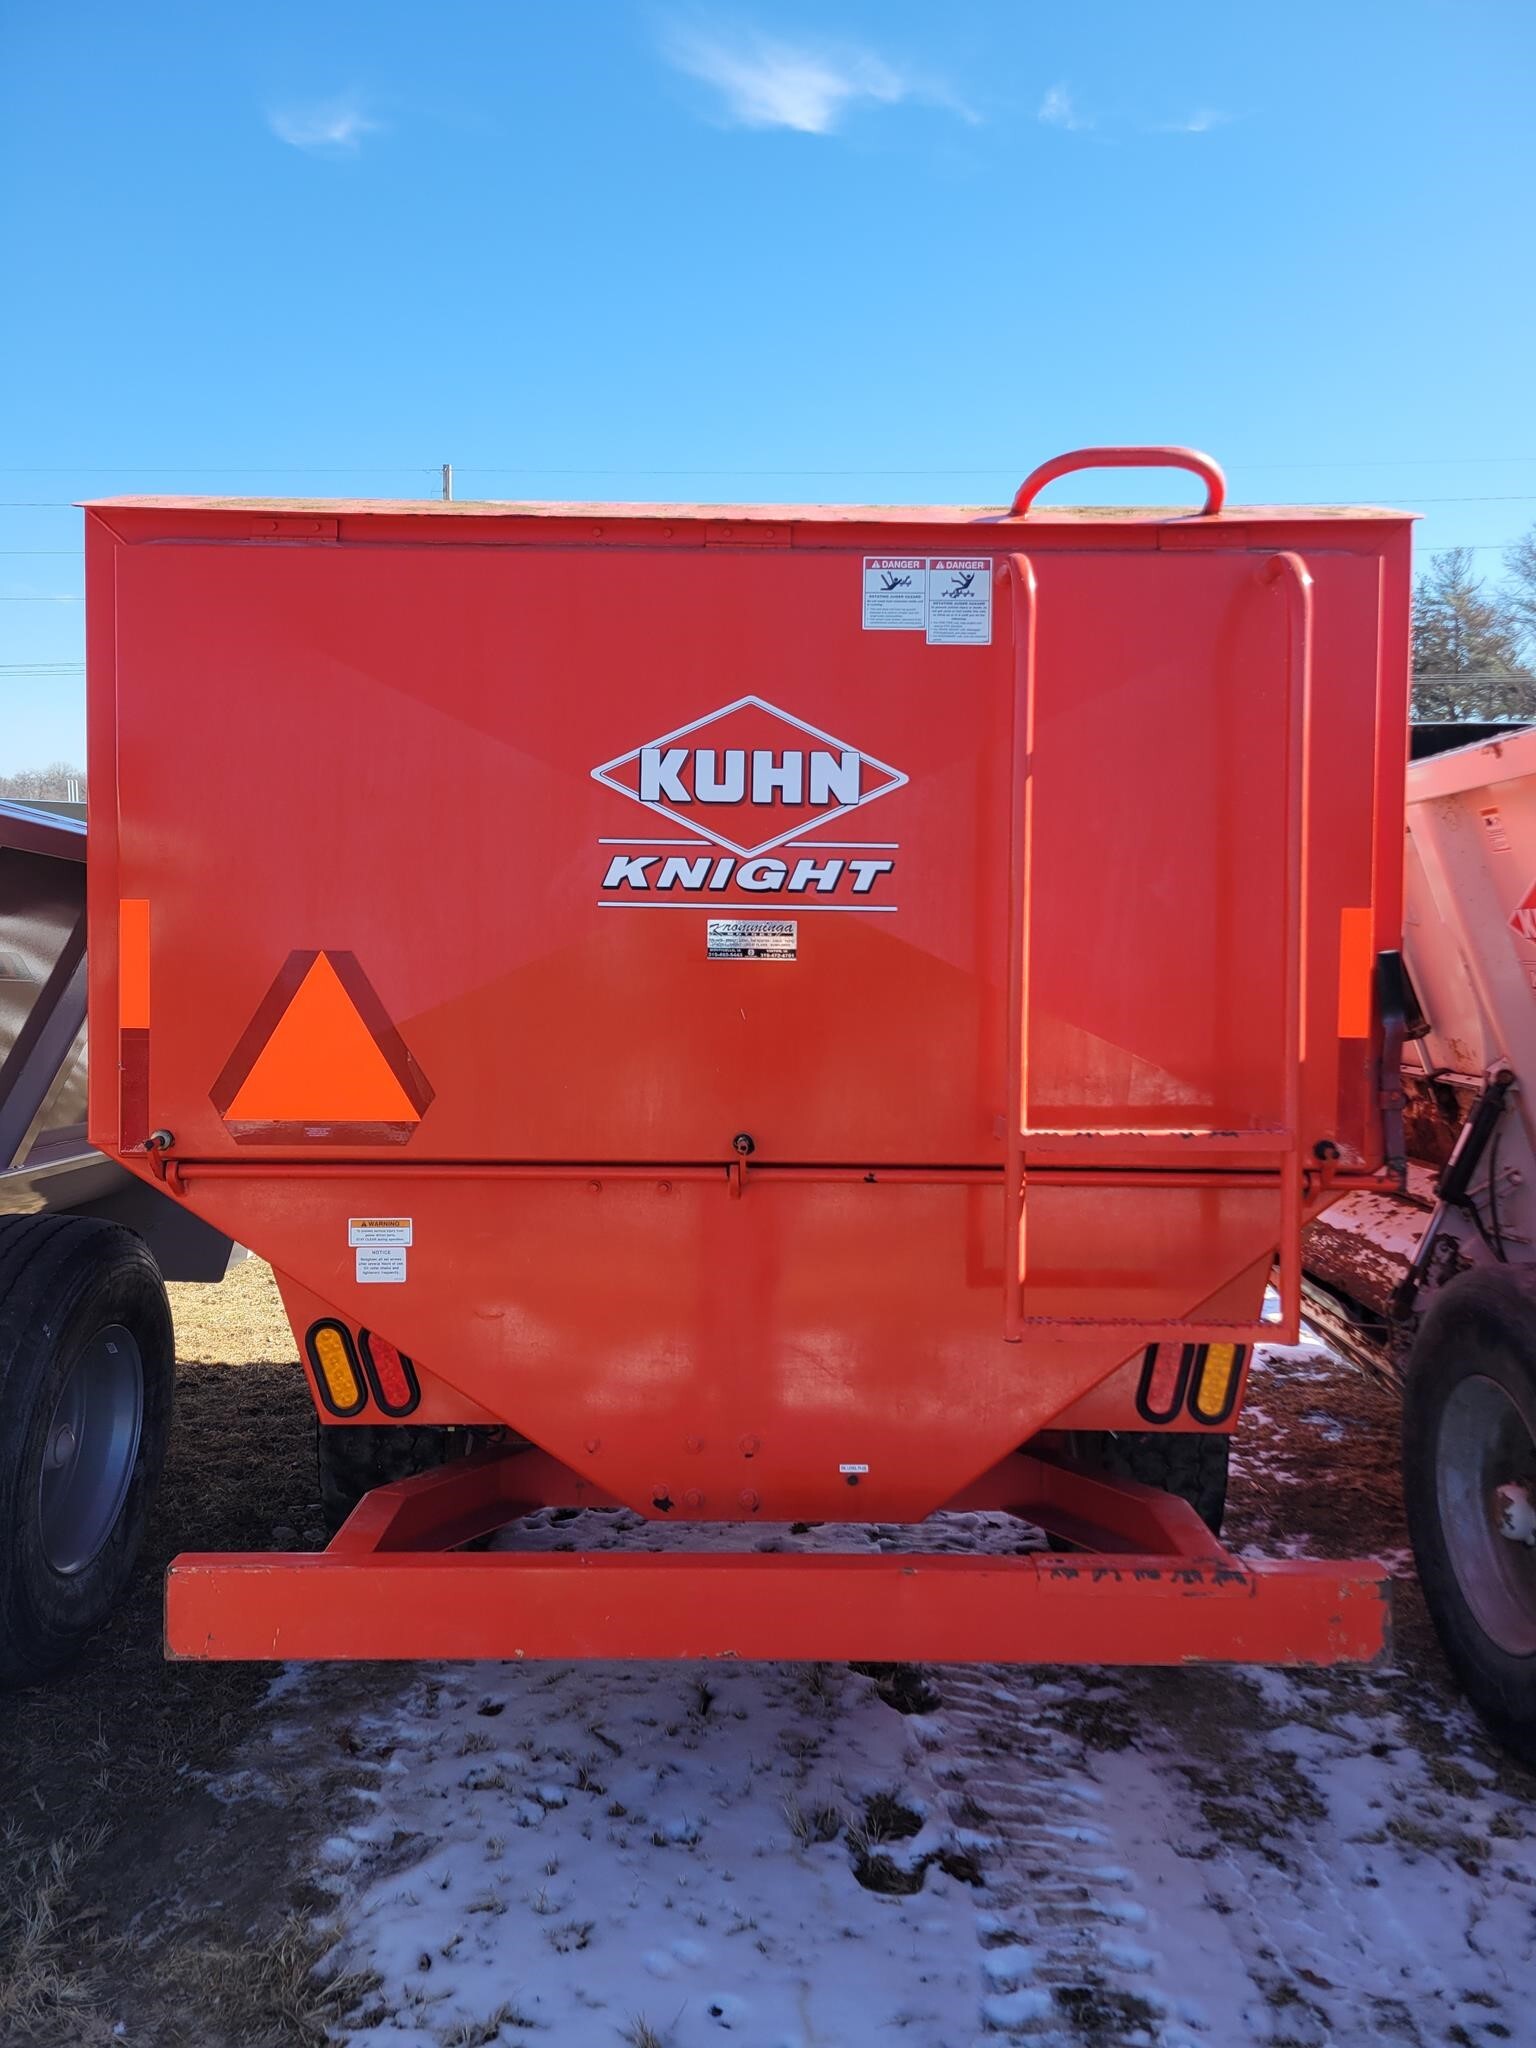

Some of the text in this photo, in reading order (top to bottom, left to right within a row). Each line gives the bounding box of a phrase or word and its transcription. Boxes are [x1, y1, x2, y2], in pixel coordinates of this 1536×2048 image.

[881, 560, 920, 569] DANGER
[946, 561, 984, 569] DANGER
[639, 748, 861, 805] KUHN
[602, 856, 894, 893] KNIGHT
[709, 922, 793, 936] Kromminga
